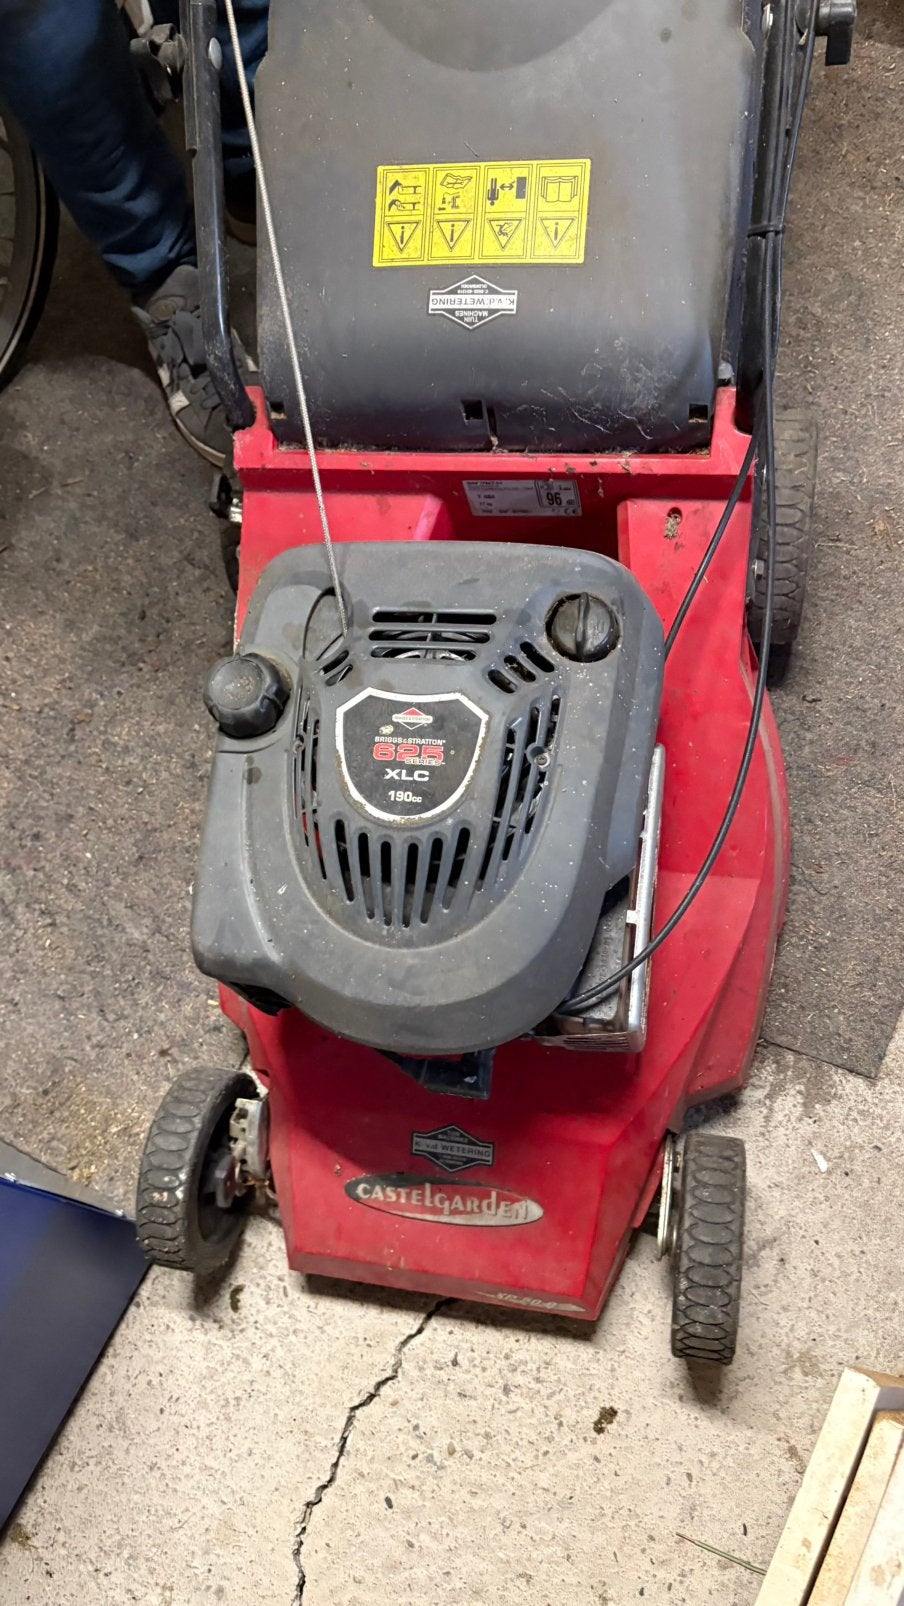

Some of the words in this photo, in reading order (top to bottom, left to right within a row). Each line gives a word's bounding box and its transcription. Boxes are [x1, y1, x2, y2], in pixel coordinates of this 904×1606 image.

[431, 297, 484, 306] WETERING
[546, 491, 562, 506] 96
[373, 743, 444, 761] 625
[384, 768, 430, 781] XLC
[388, 790, 422, 803] 190cc
[441, 1143, 491, 1158] WETERING
